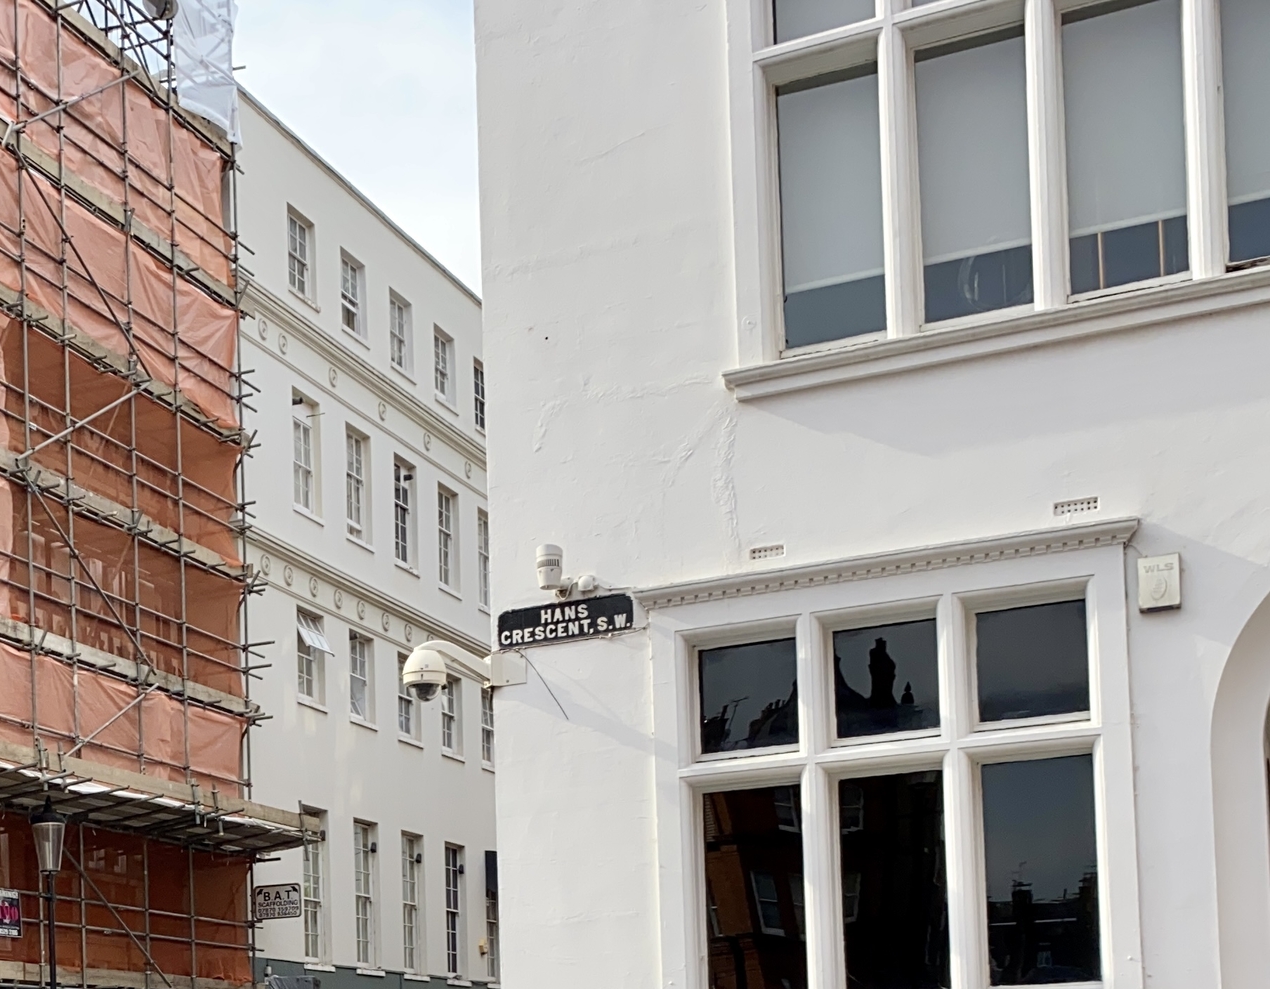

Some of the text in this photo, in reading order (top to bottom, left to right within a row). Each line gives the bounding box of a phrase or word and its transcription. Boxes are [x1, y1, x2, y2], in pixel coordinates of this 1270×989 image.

[1143, 562, 1174, 573] WLS
[540, 604, 588, 624] HANS
[501, 619, 594, 645] CRESCENT,
